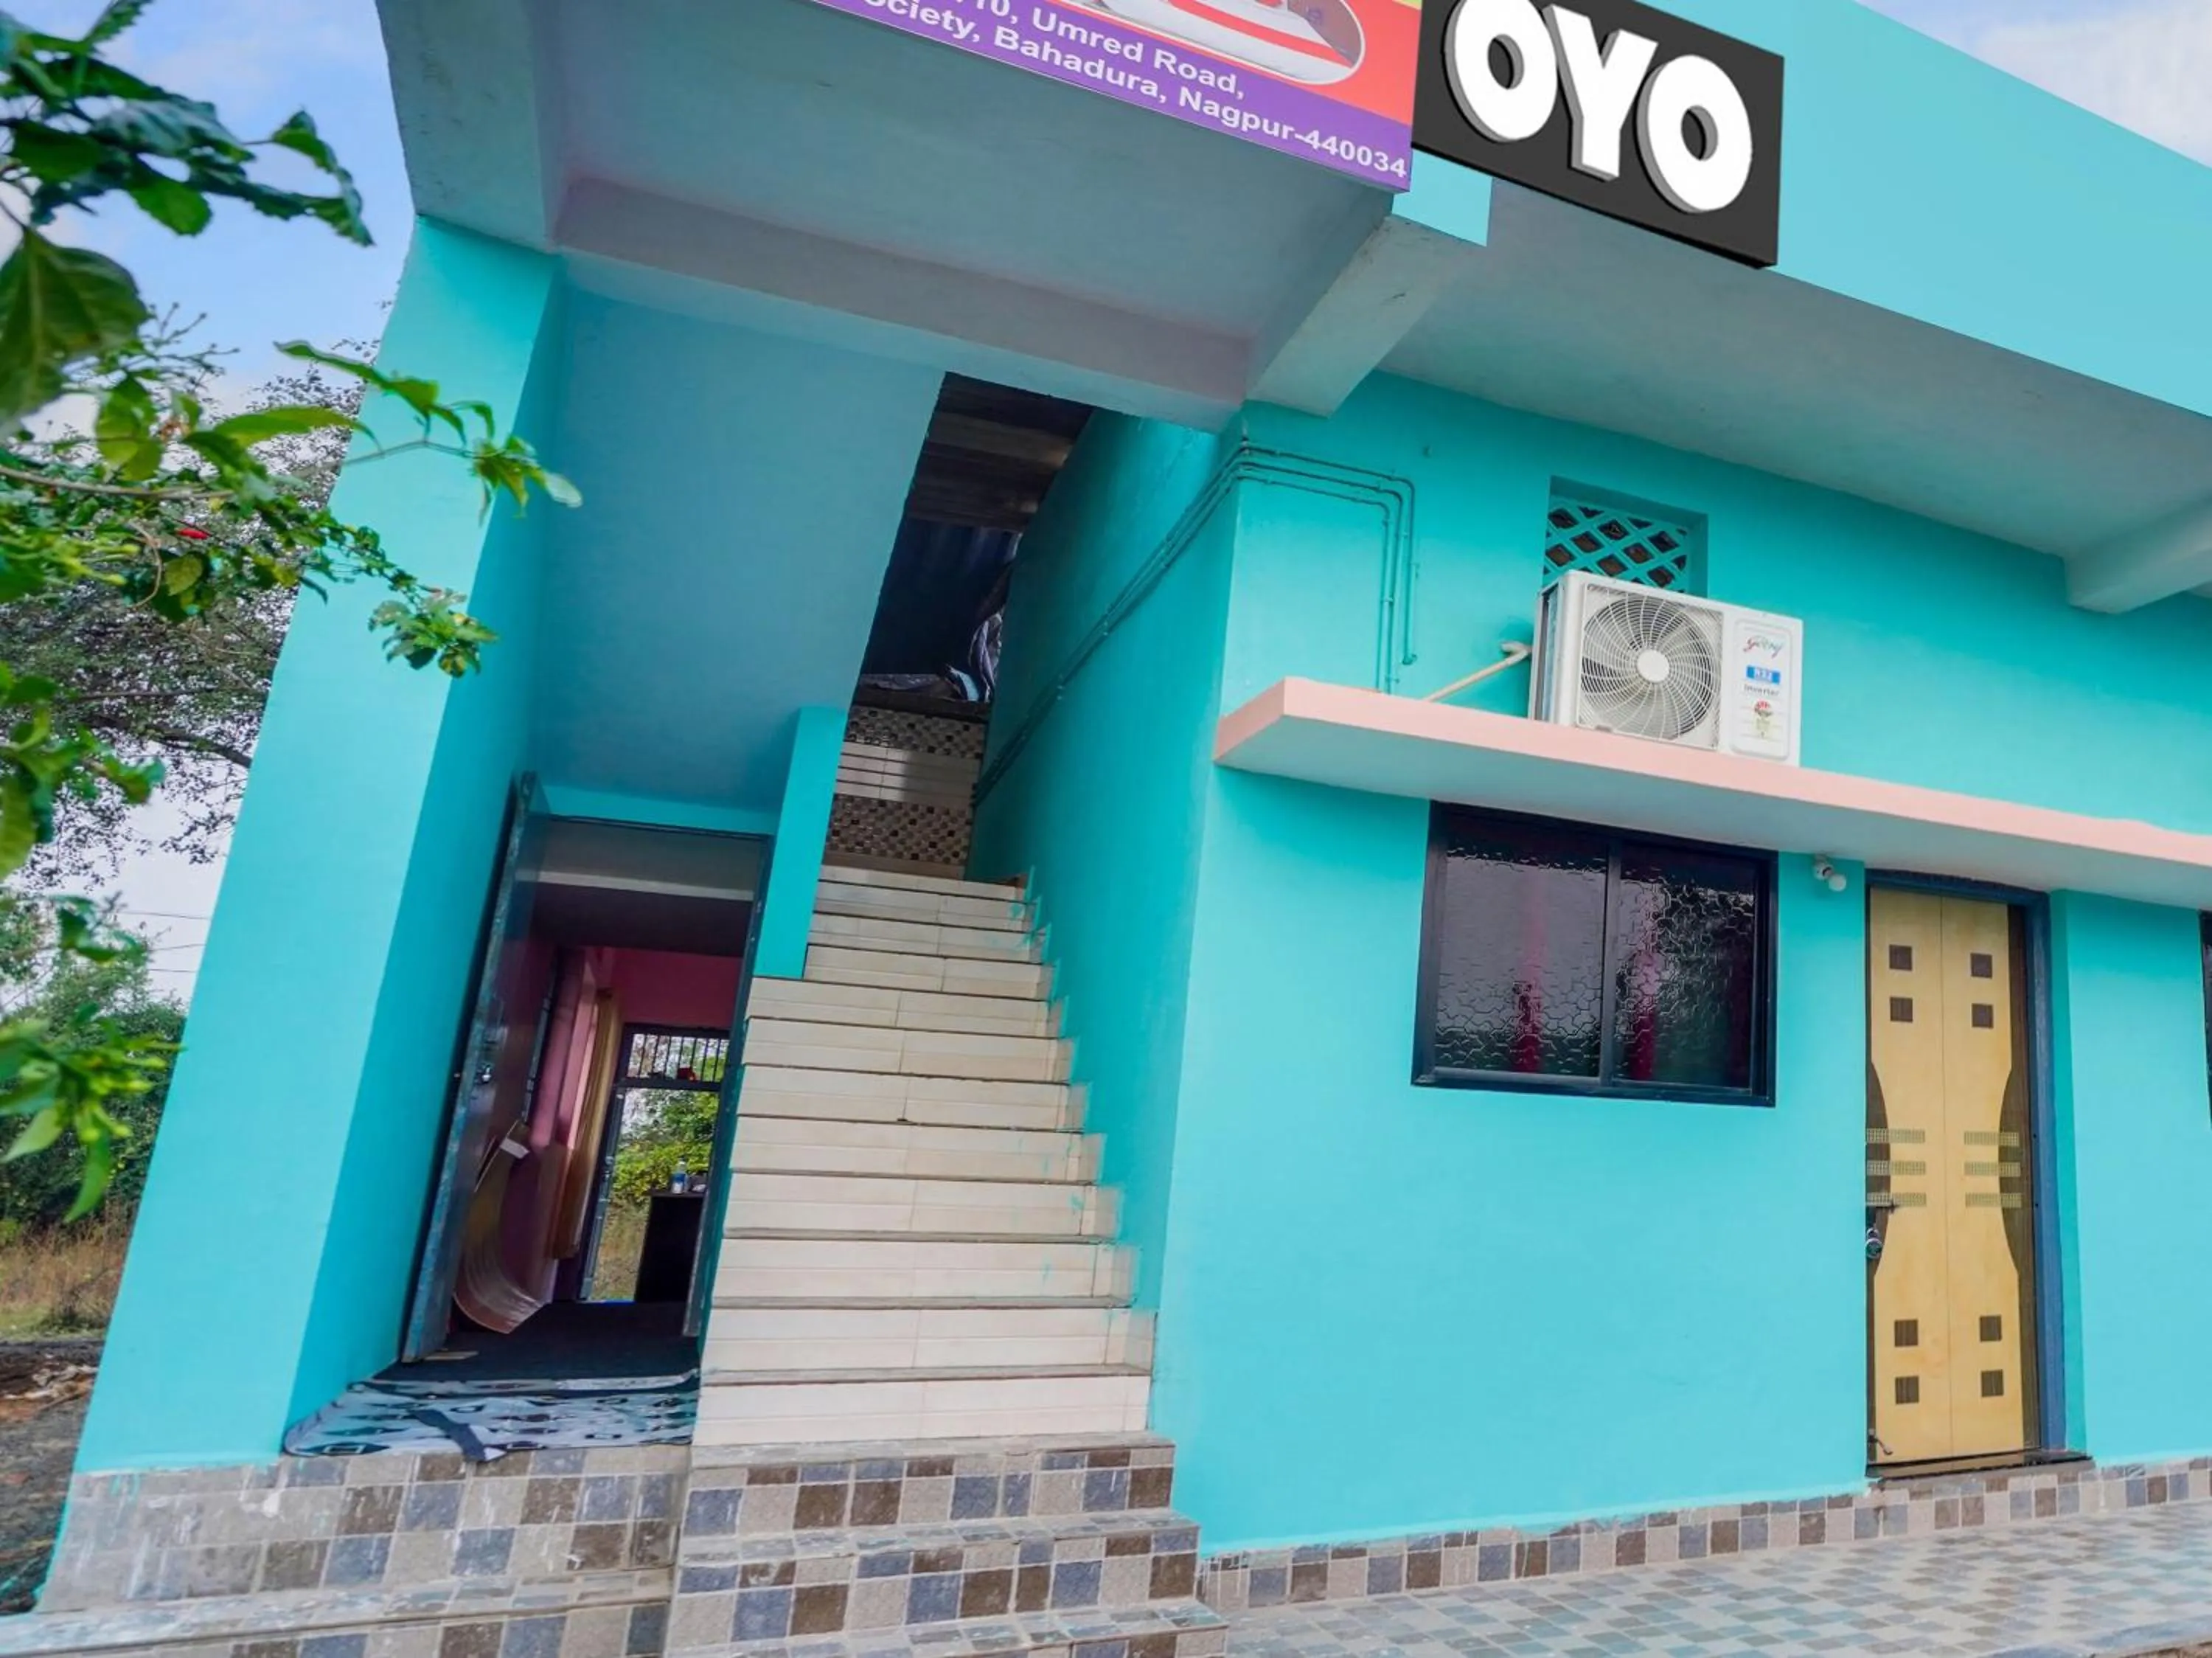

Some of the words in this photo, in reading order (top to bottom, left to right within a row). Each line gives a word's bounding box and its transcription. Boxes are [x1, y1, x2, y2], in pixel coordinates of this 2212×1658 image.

[993, 25, 1167, 103] Bahadura,
[1178, 86, 1408, 178] Nagpur-440034
[1032, 7, 1144, 63] Umred
[1153, 49, 1245, 99] Road,
[1444, 0, 1753, 214] OYO
